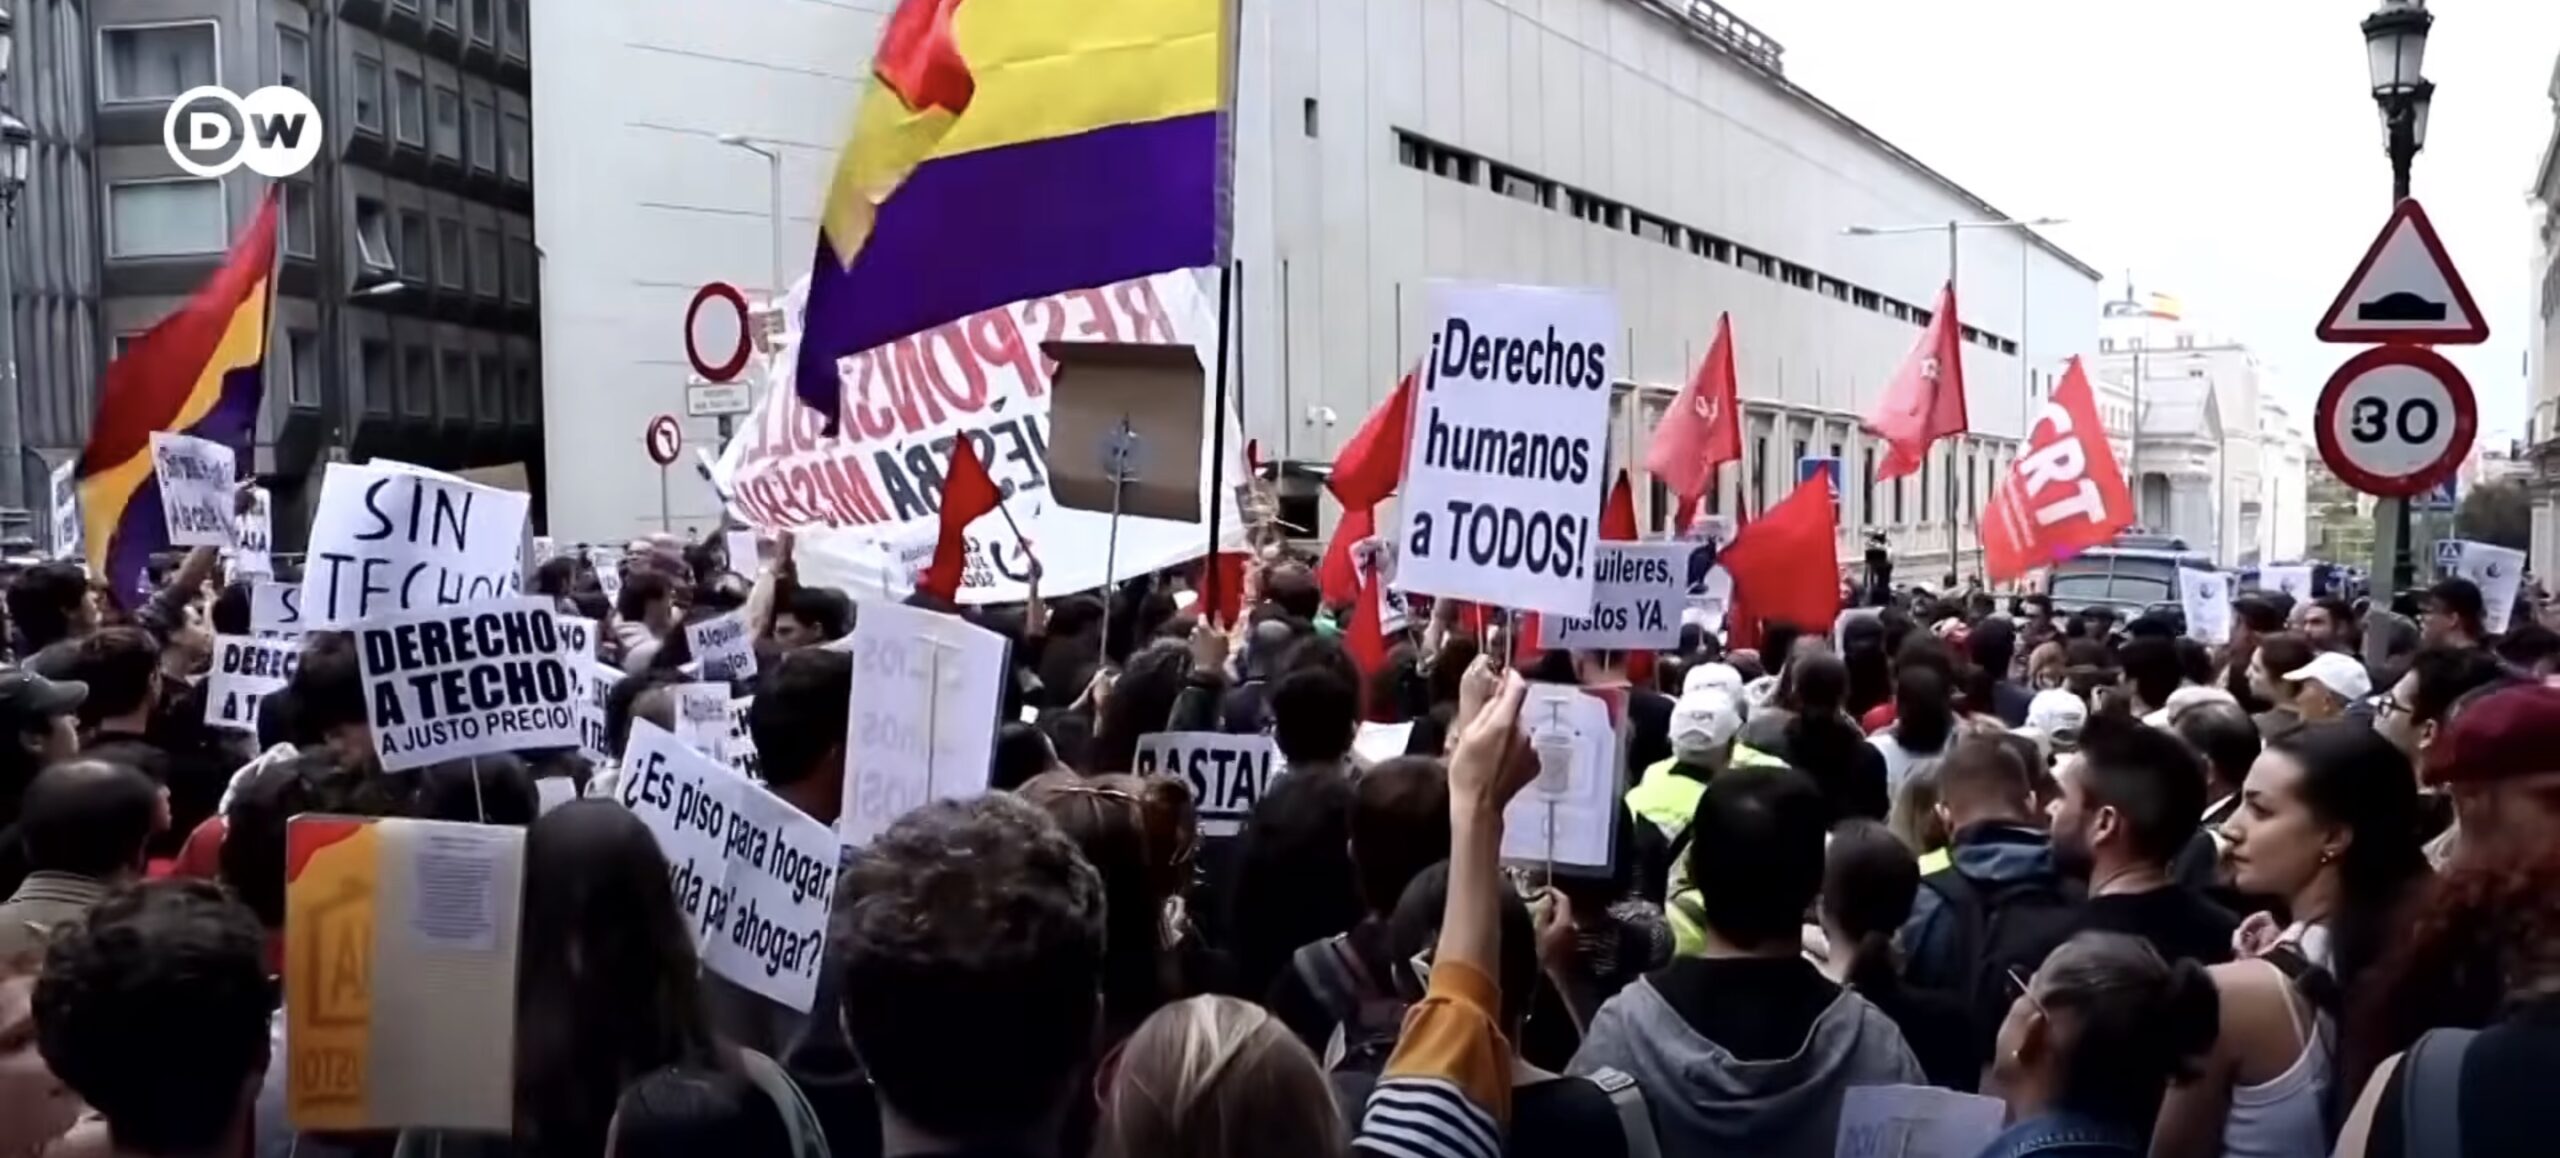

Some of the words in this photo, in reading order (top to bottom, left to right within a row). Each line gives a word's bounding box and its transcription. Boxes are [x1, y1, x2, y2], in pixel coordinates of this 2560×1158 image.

[1426, 318, 1606, 391] ¡Derechos
[1425, 407, 1589, 484] humanos
[2352, 396, 2438, 445] 30
[2018, 401, 2107, 525] CRT
[354, 478, 473, 552] SIN
[1410, 511, 1433, 558] a
[1448, 501, 1588, 579] TODOS!
[1595, 551, 1674, 587] uileres,
[364, 609, 557, 676] DERECHO
[1636, 600, 1668, 631] YA.
[223, 643, 300, 683] DEREC
[375, 680, 405, 728] A
[408, 659, 568, 720] TECHO
[381, 732, 399, 756] A
[404, 717, 480, 751] JUSTO
[486, 705, 575, 736] PRECIO!
[624, 749, 674, 811] ¿Es
[674, 777, 723, 838] piso
[723, 811, 768, 869] para
[769, 826, 832, 914] hogar,
[732, 898, 822, 979] ahogar?
